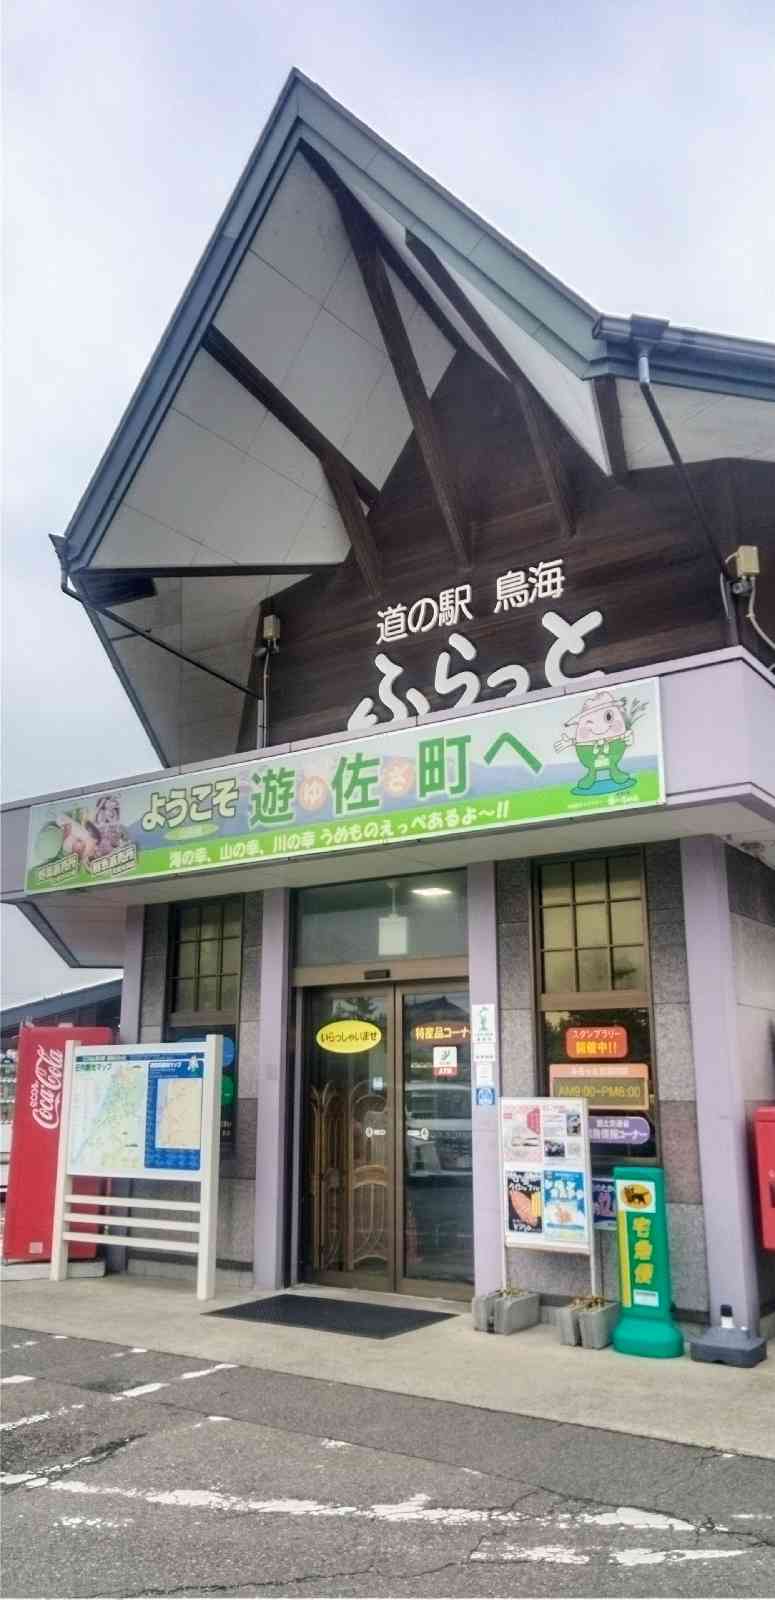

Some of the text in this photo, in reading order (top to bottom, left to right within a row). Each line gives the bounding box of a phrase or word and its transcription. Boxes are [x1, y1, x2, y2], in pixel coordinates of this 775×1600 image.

[376, 558, 566, 645] 道の駅 鳥海
[347, 610, 604, 731] ふらっと
[142, 776, 240, 831] ようこそ
[320, 1031, 378, 1043] いらっしゃいませ
[415, 1026, 471, 1041] 特産品コーナ
